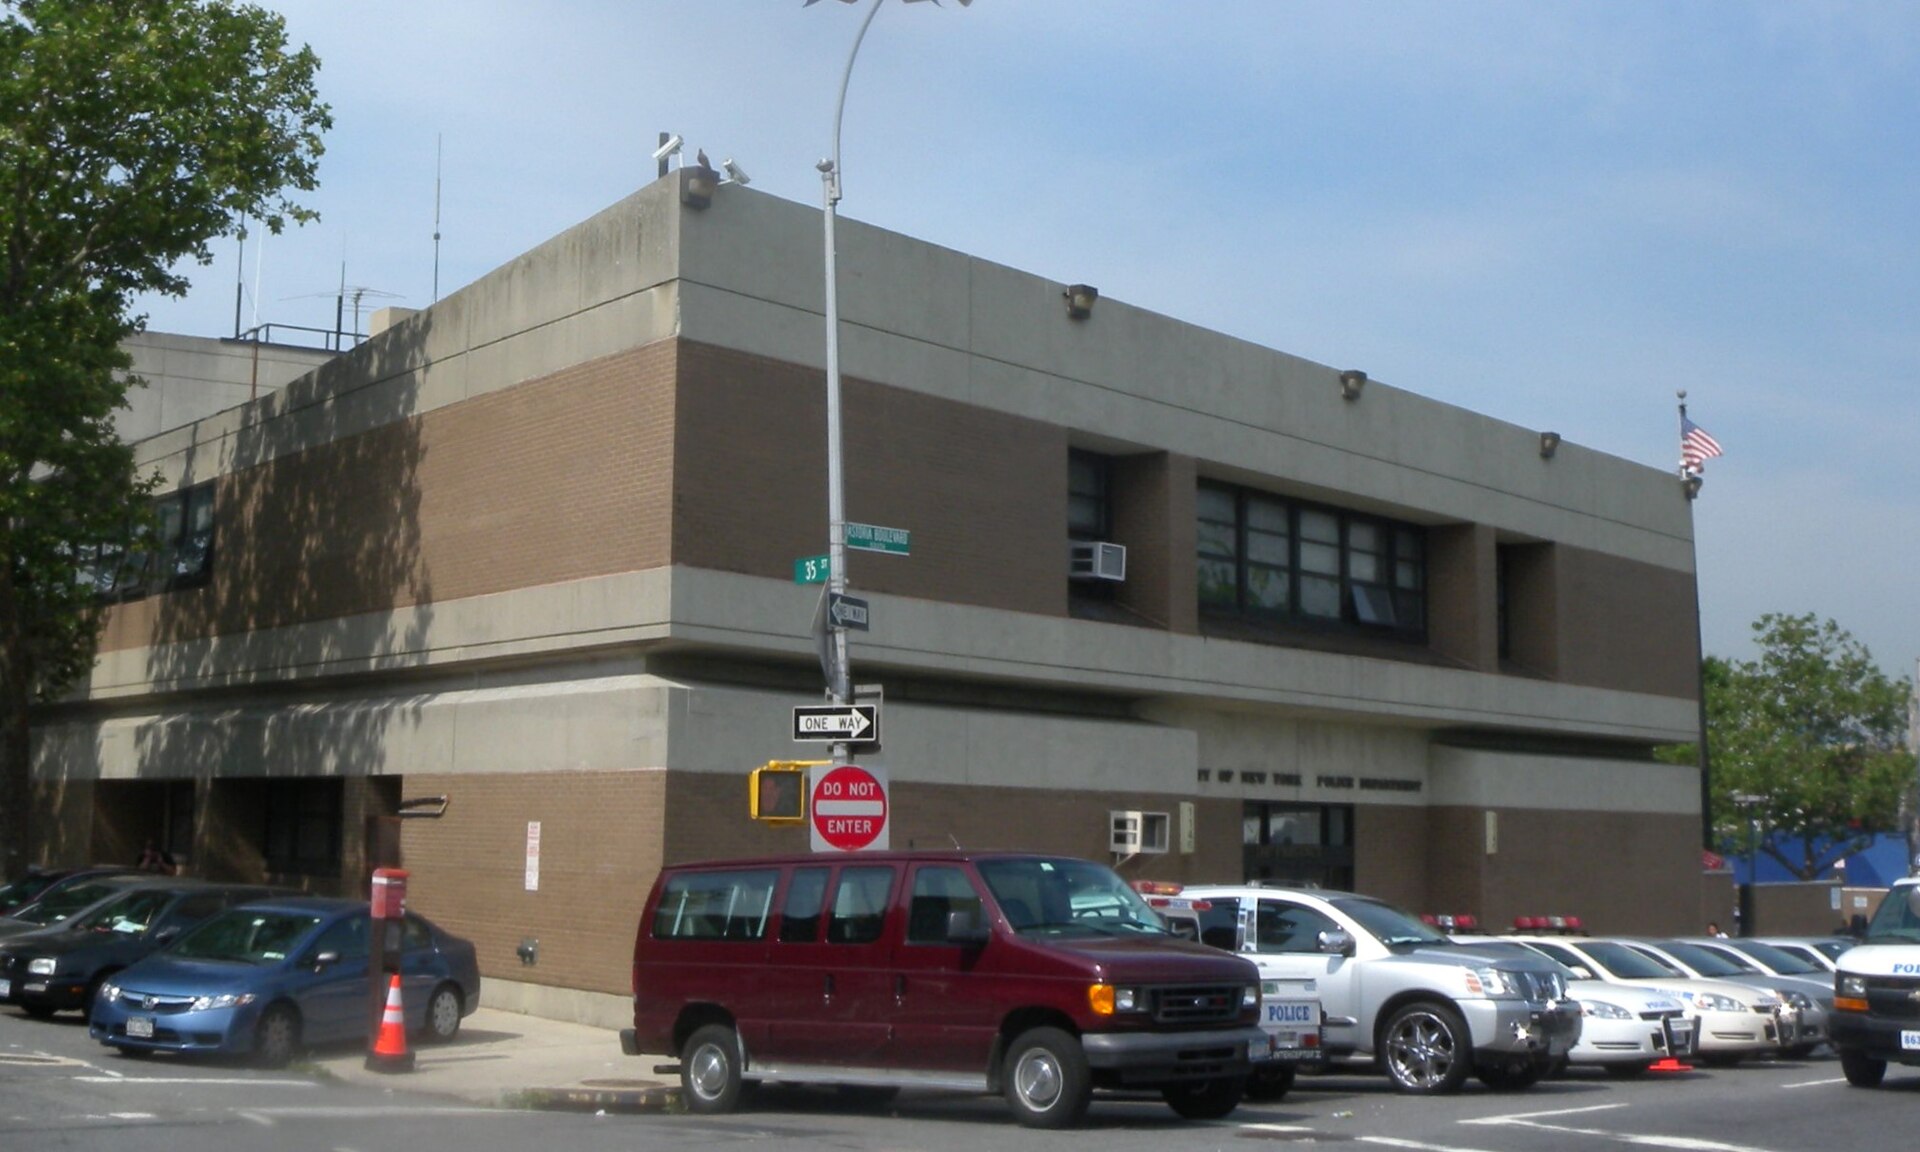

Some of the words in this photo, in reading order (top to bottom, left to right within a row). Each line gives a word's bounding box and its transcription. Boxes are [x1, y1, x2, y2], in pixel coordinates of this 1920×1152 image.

[805, 560, 817, 580] 35
[820, 558, 828, 569] ST
[805, 717, 828, 730] ONE
[838, 717, 862, 730] WAY
[1241, 771, 1267, 784] NEW
[1316, 775, 1354, 789] POLICE
[824, 782, 842, 796] DO
[849, 782, 875, 796] NOT
[828, 820, 872, 833] ENTER
[1268, 1005, 1310, 1021] POLICE
